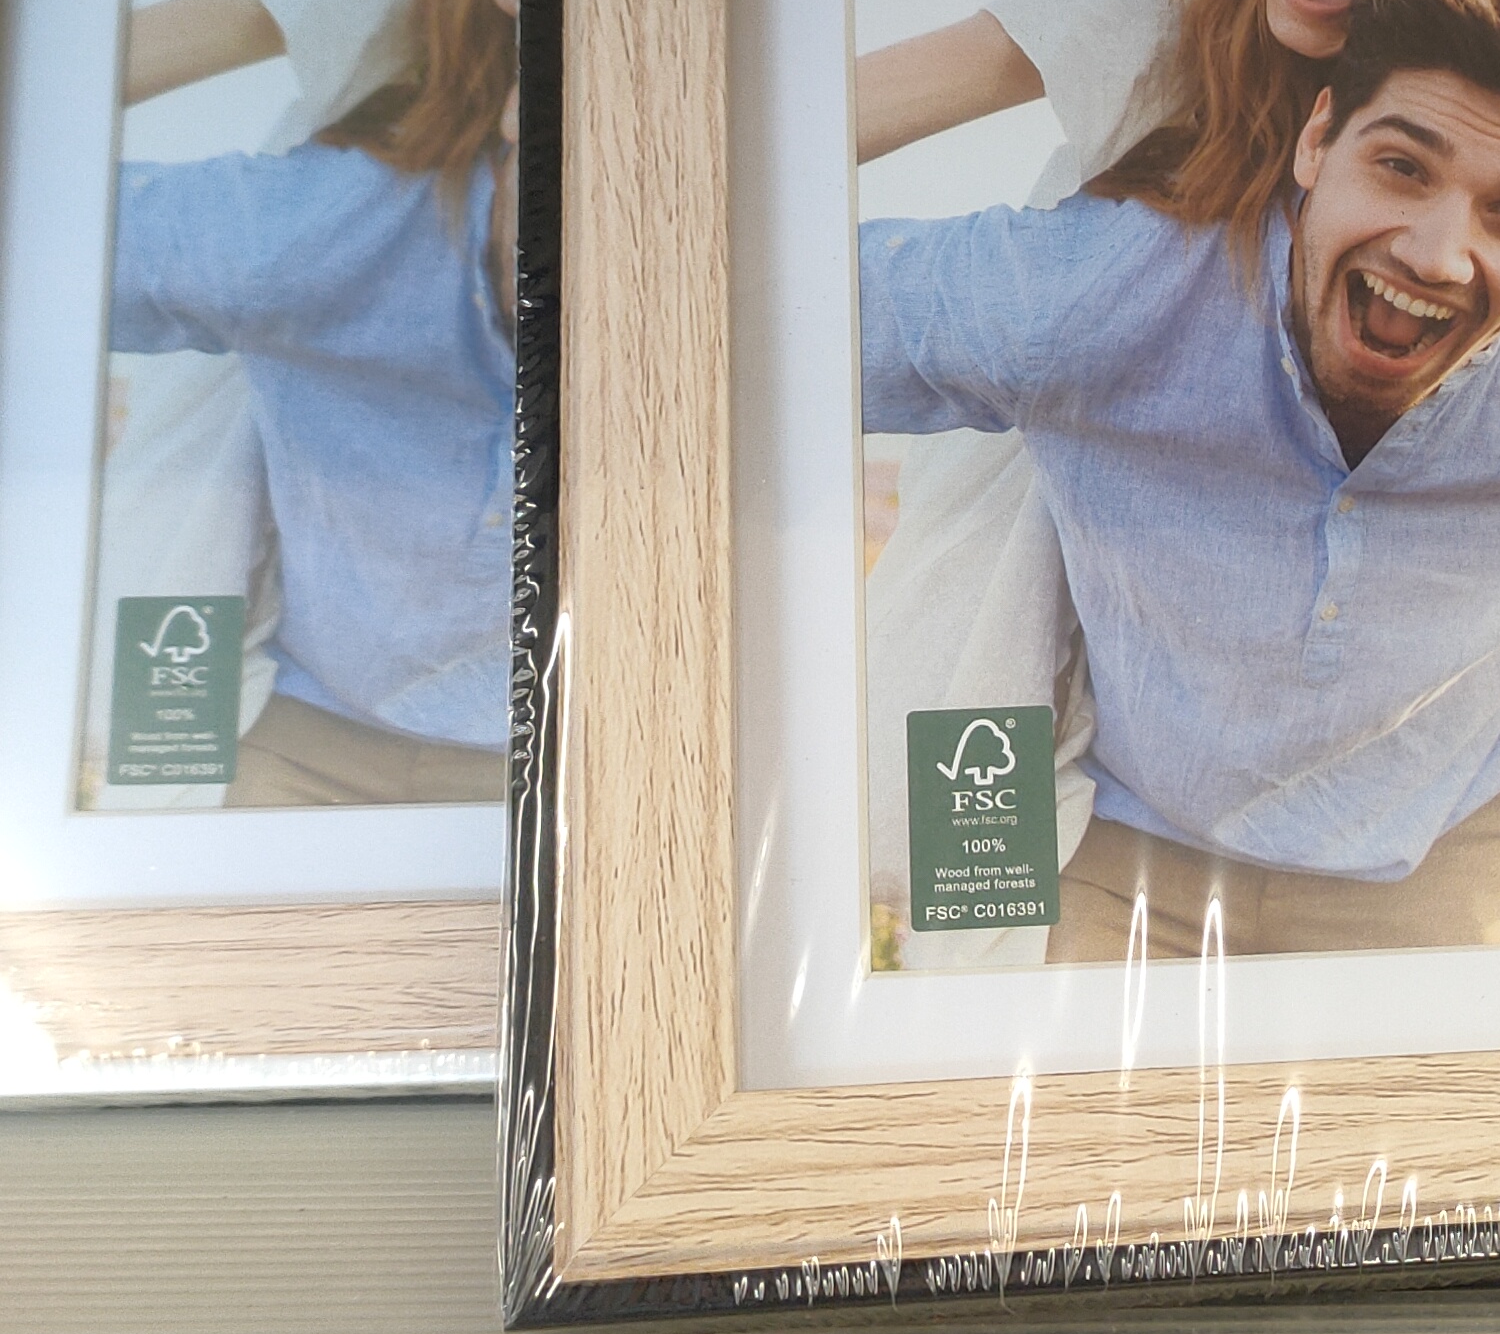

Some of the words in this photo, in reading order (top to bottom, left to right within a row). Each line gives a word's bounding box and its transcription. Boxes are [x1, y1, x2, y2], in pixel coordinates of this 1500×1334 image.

[951, 788, 1017, 812] FSC
[951, 814, 1018, 827] www.fsc.org
[961, 838, 1007, 854] 100%
[934, 866, 970, 879] Wood
[973, 865, 1002, 877] from
[1004, 863, 1035, 876] well-
[934, 878, 990, 893] managed
[994, 878, 1036, 890] forests
[973, 901, 1046, 919] C016391
